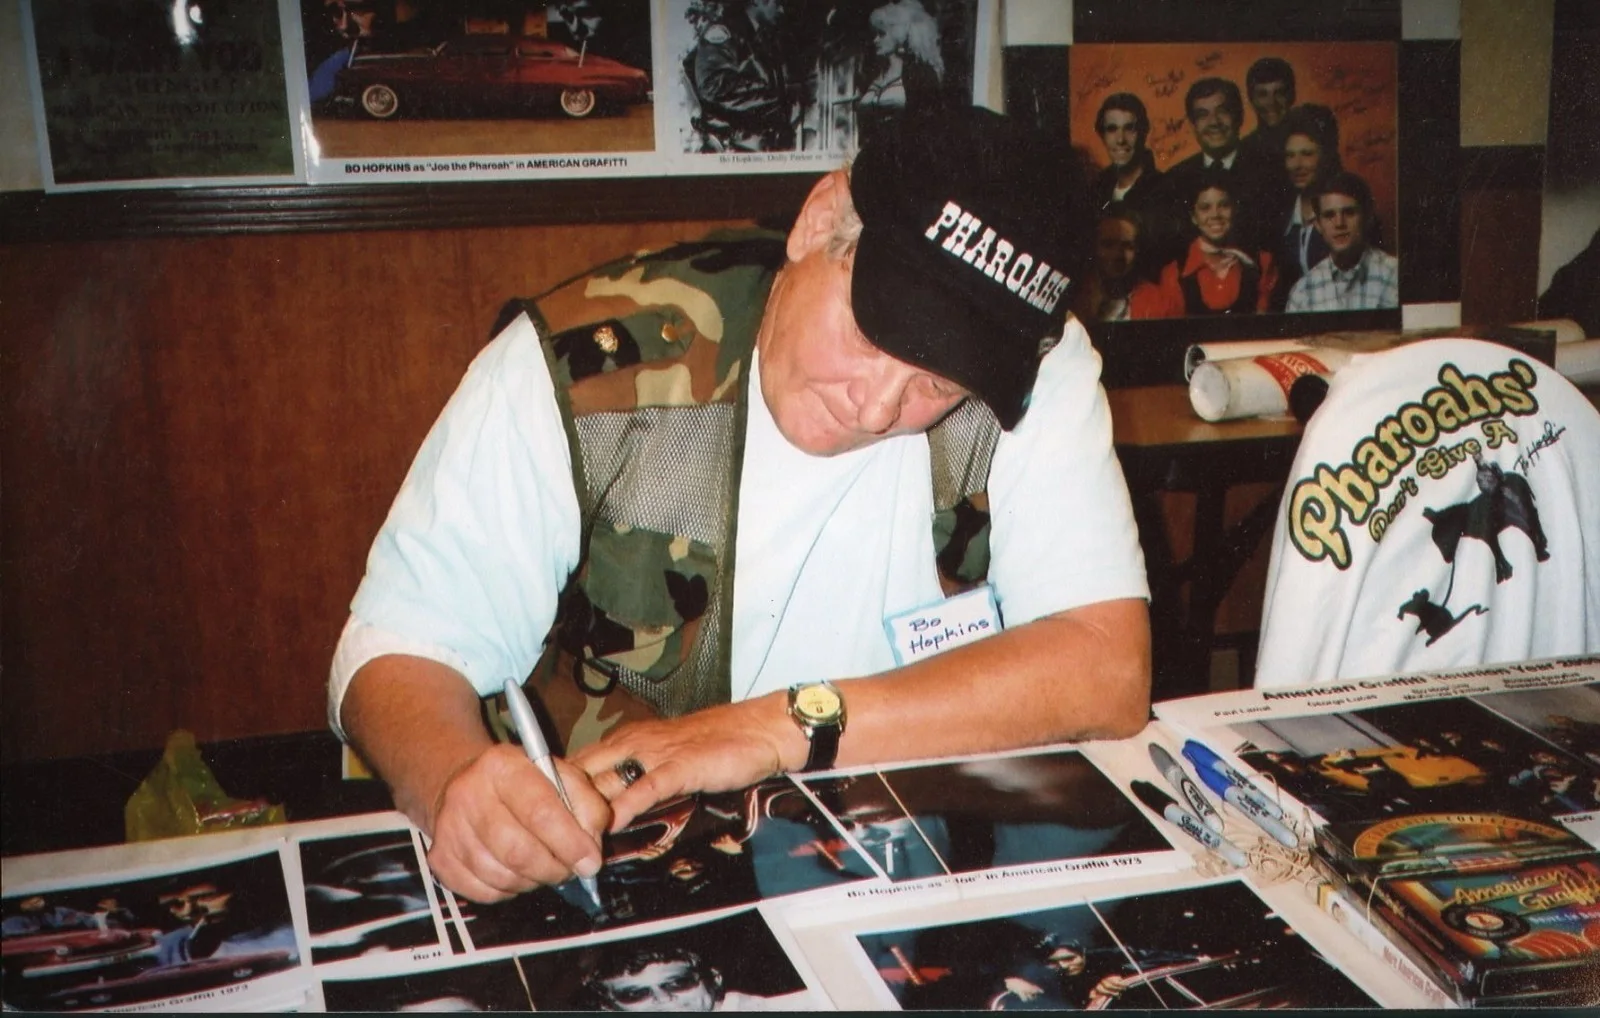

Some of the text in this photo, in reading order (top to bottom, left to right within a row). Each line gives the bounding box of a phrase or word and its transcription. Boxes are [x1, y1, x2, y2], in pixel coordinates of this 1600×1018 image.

[345, 163, 360, 173] BO
[362, 162, 411, 173] HOPKINS
[413, 163, 425, 172] as
[427, 162, 450, 172] "Joe
[451, 161, 467, 171] the
[516, 161, 525, 169] in
[526, 158, 580, 169] AMERICAN
[582, 157, 628, 168] GRAFITTI
[925, 201, 1070, 314] PHAROAHS
[1369, 419, 1518, 543] Don't Give A
[909, 617, 942, 632] Bo
[909, 618, 990, 654] Hopkins
[1262, 684, 1357, 700] American
[1002, 866, 1063, 879] American
[1064, 860, 1110, 872] Graffiti
[1112, 856, 1143, 867] 1973
